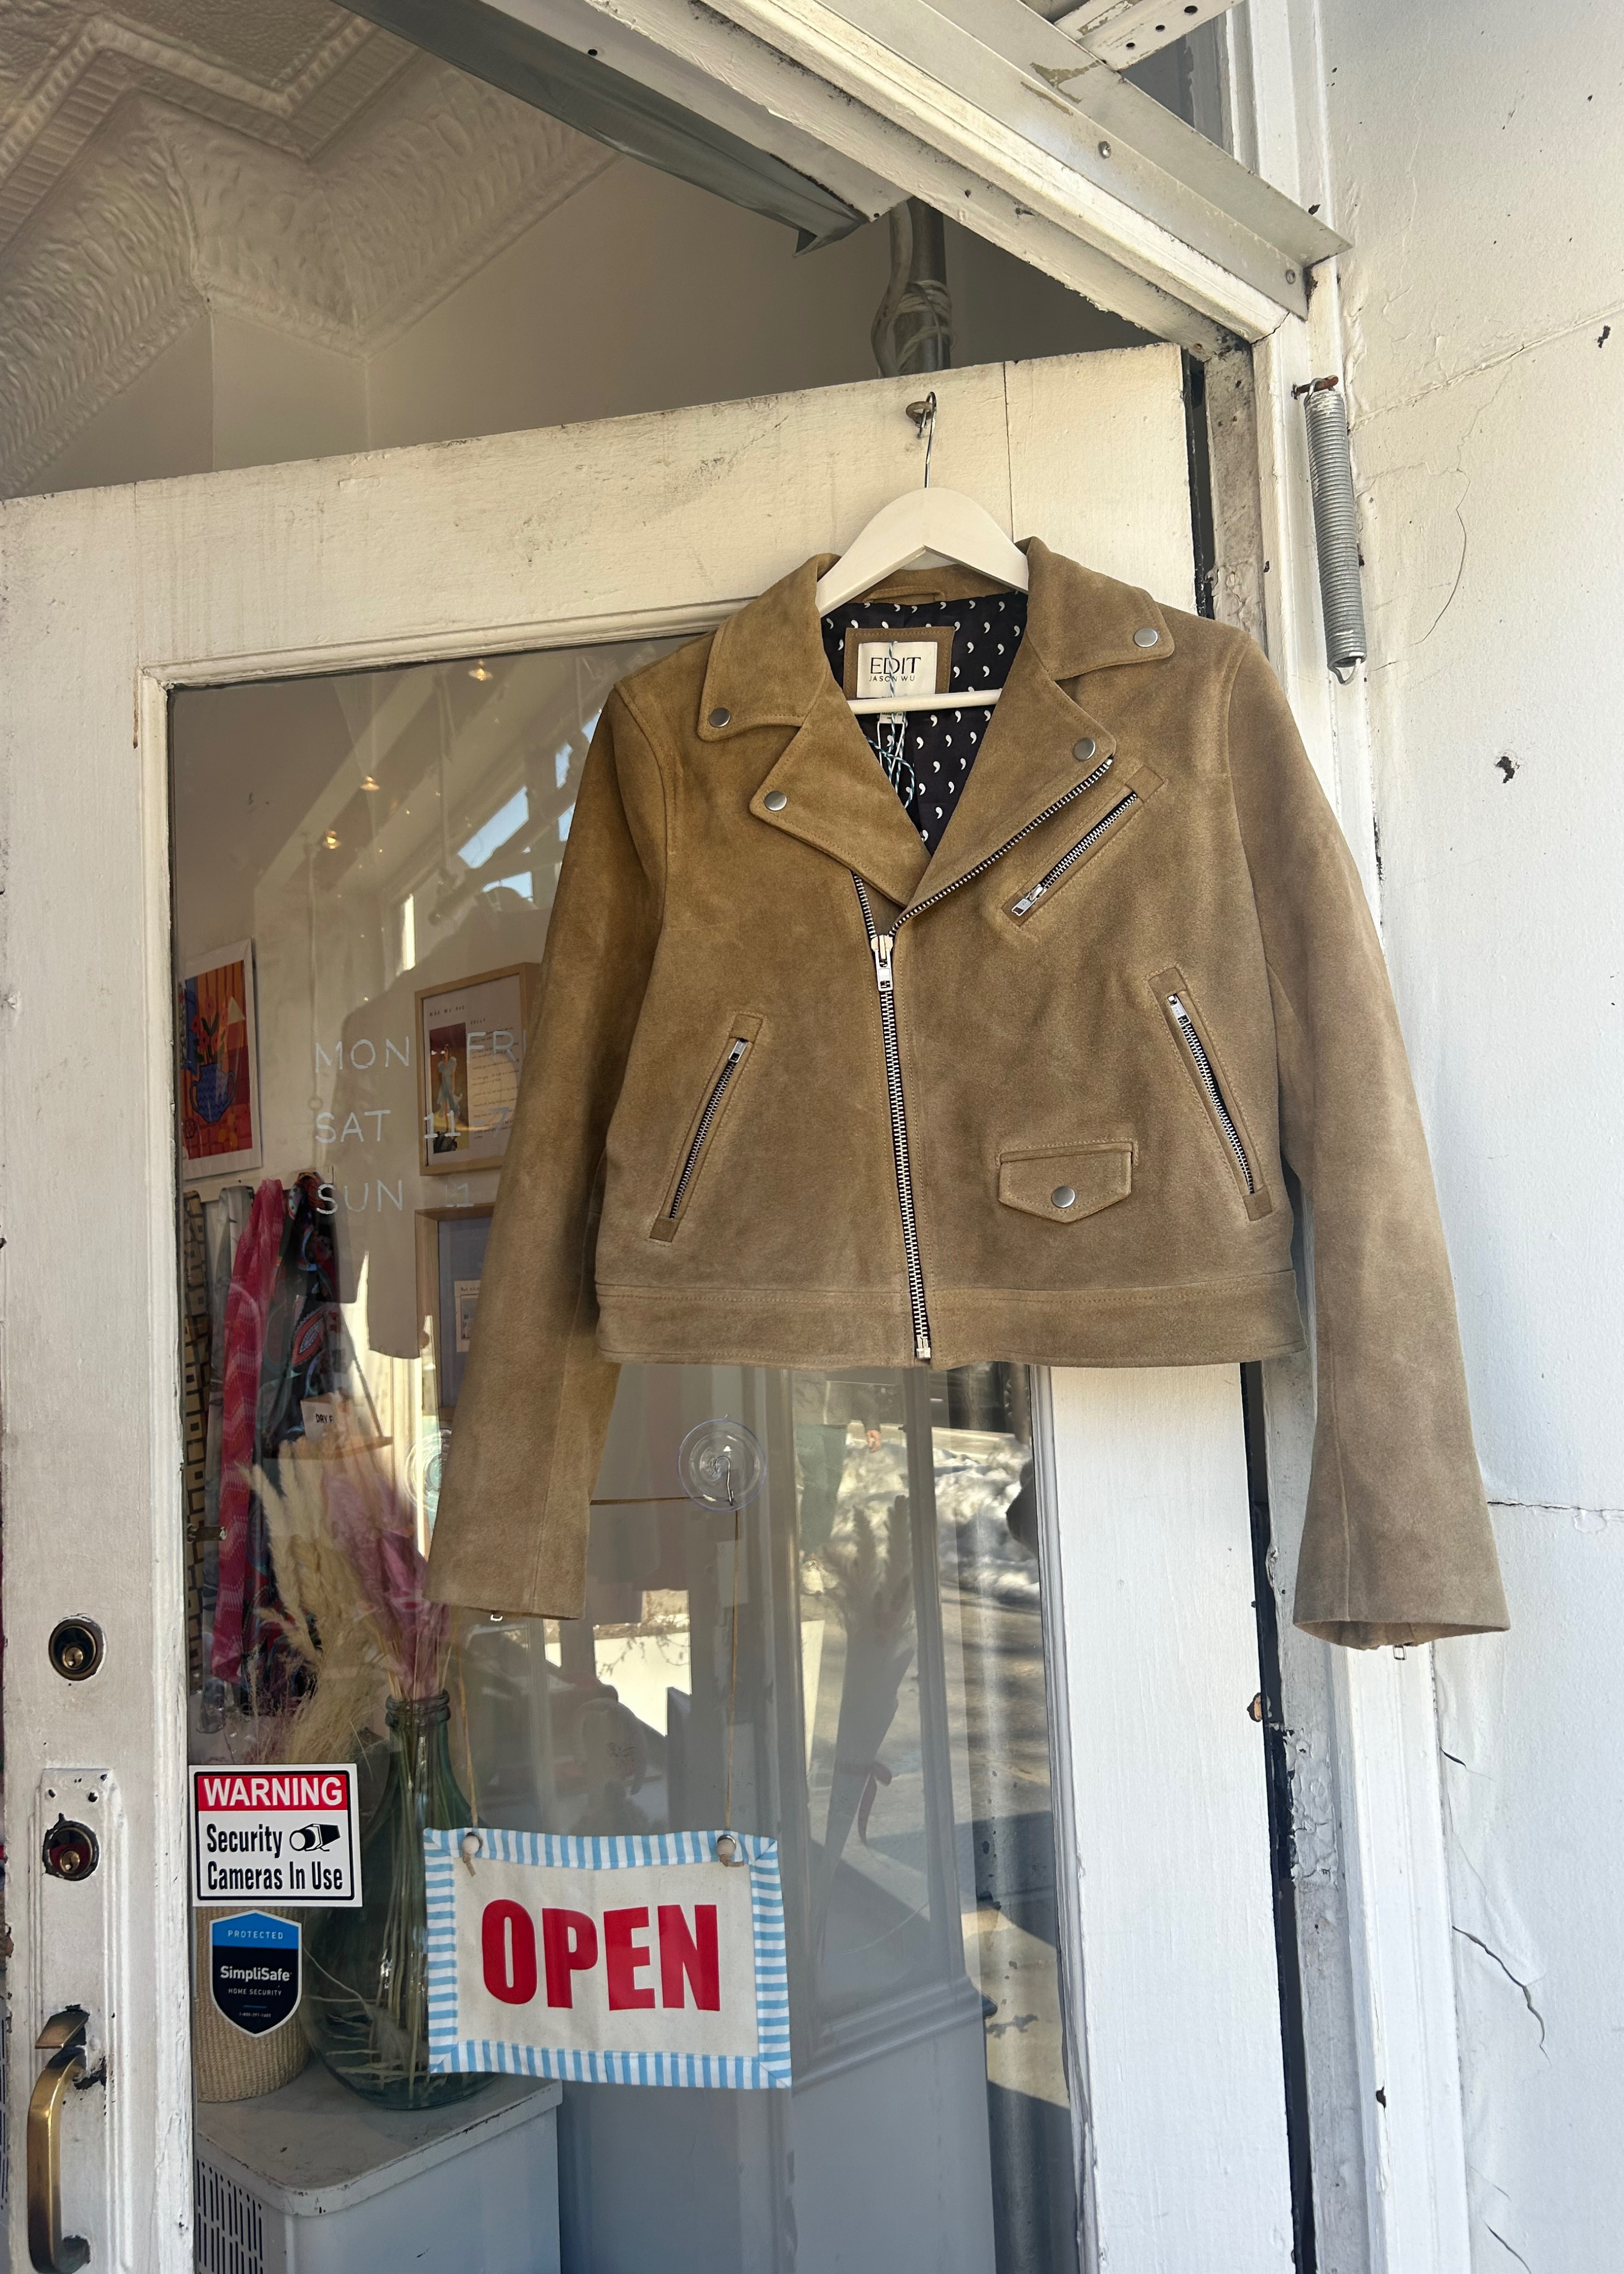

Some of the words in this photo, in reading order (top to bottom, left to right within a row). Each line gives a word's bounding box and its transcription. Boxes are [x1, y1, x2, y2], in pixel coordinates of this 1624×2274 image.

[870, 657, 921, 675] EDIT
[315, 1036, 410, 1074] MON
[466, 1029, 527, 1064] FRI
[315, 1109, 391, 1144] SAT
[316, 1180, 403, 1215] SUN
[203, 1777, 343, 1807] WARNING
[206, 1823, 283, 1859] Security
[208, 1860, 283, 1890] Cameras
[289, 1861, 306, 1889] In
[311, 1861, 343, 1890] Use
[228, 1930, 284, 1940] PROTECTED
[481, 1899, 720, 2011] OPEN
[220, 1965, 290, 1983] SimpliSafe
